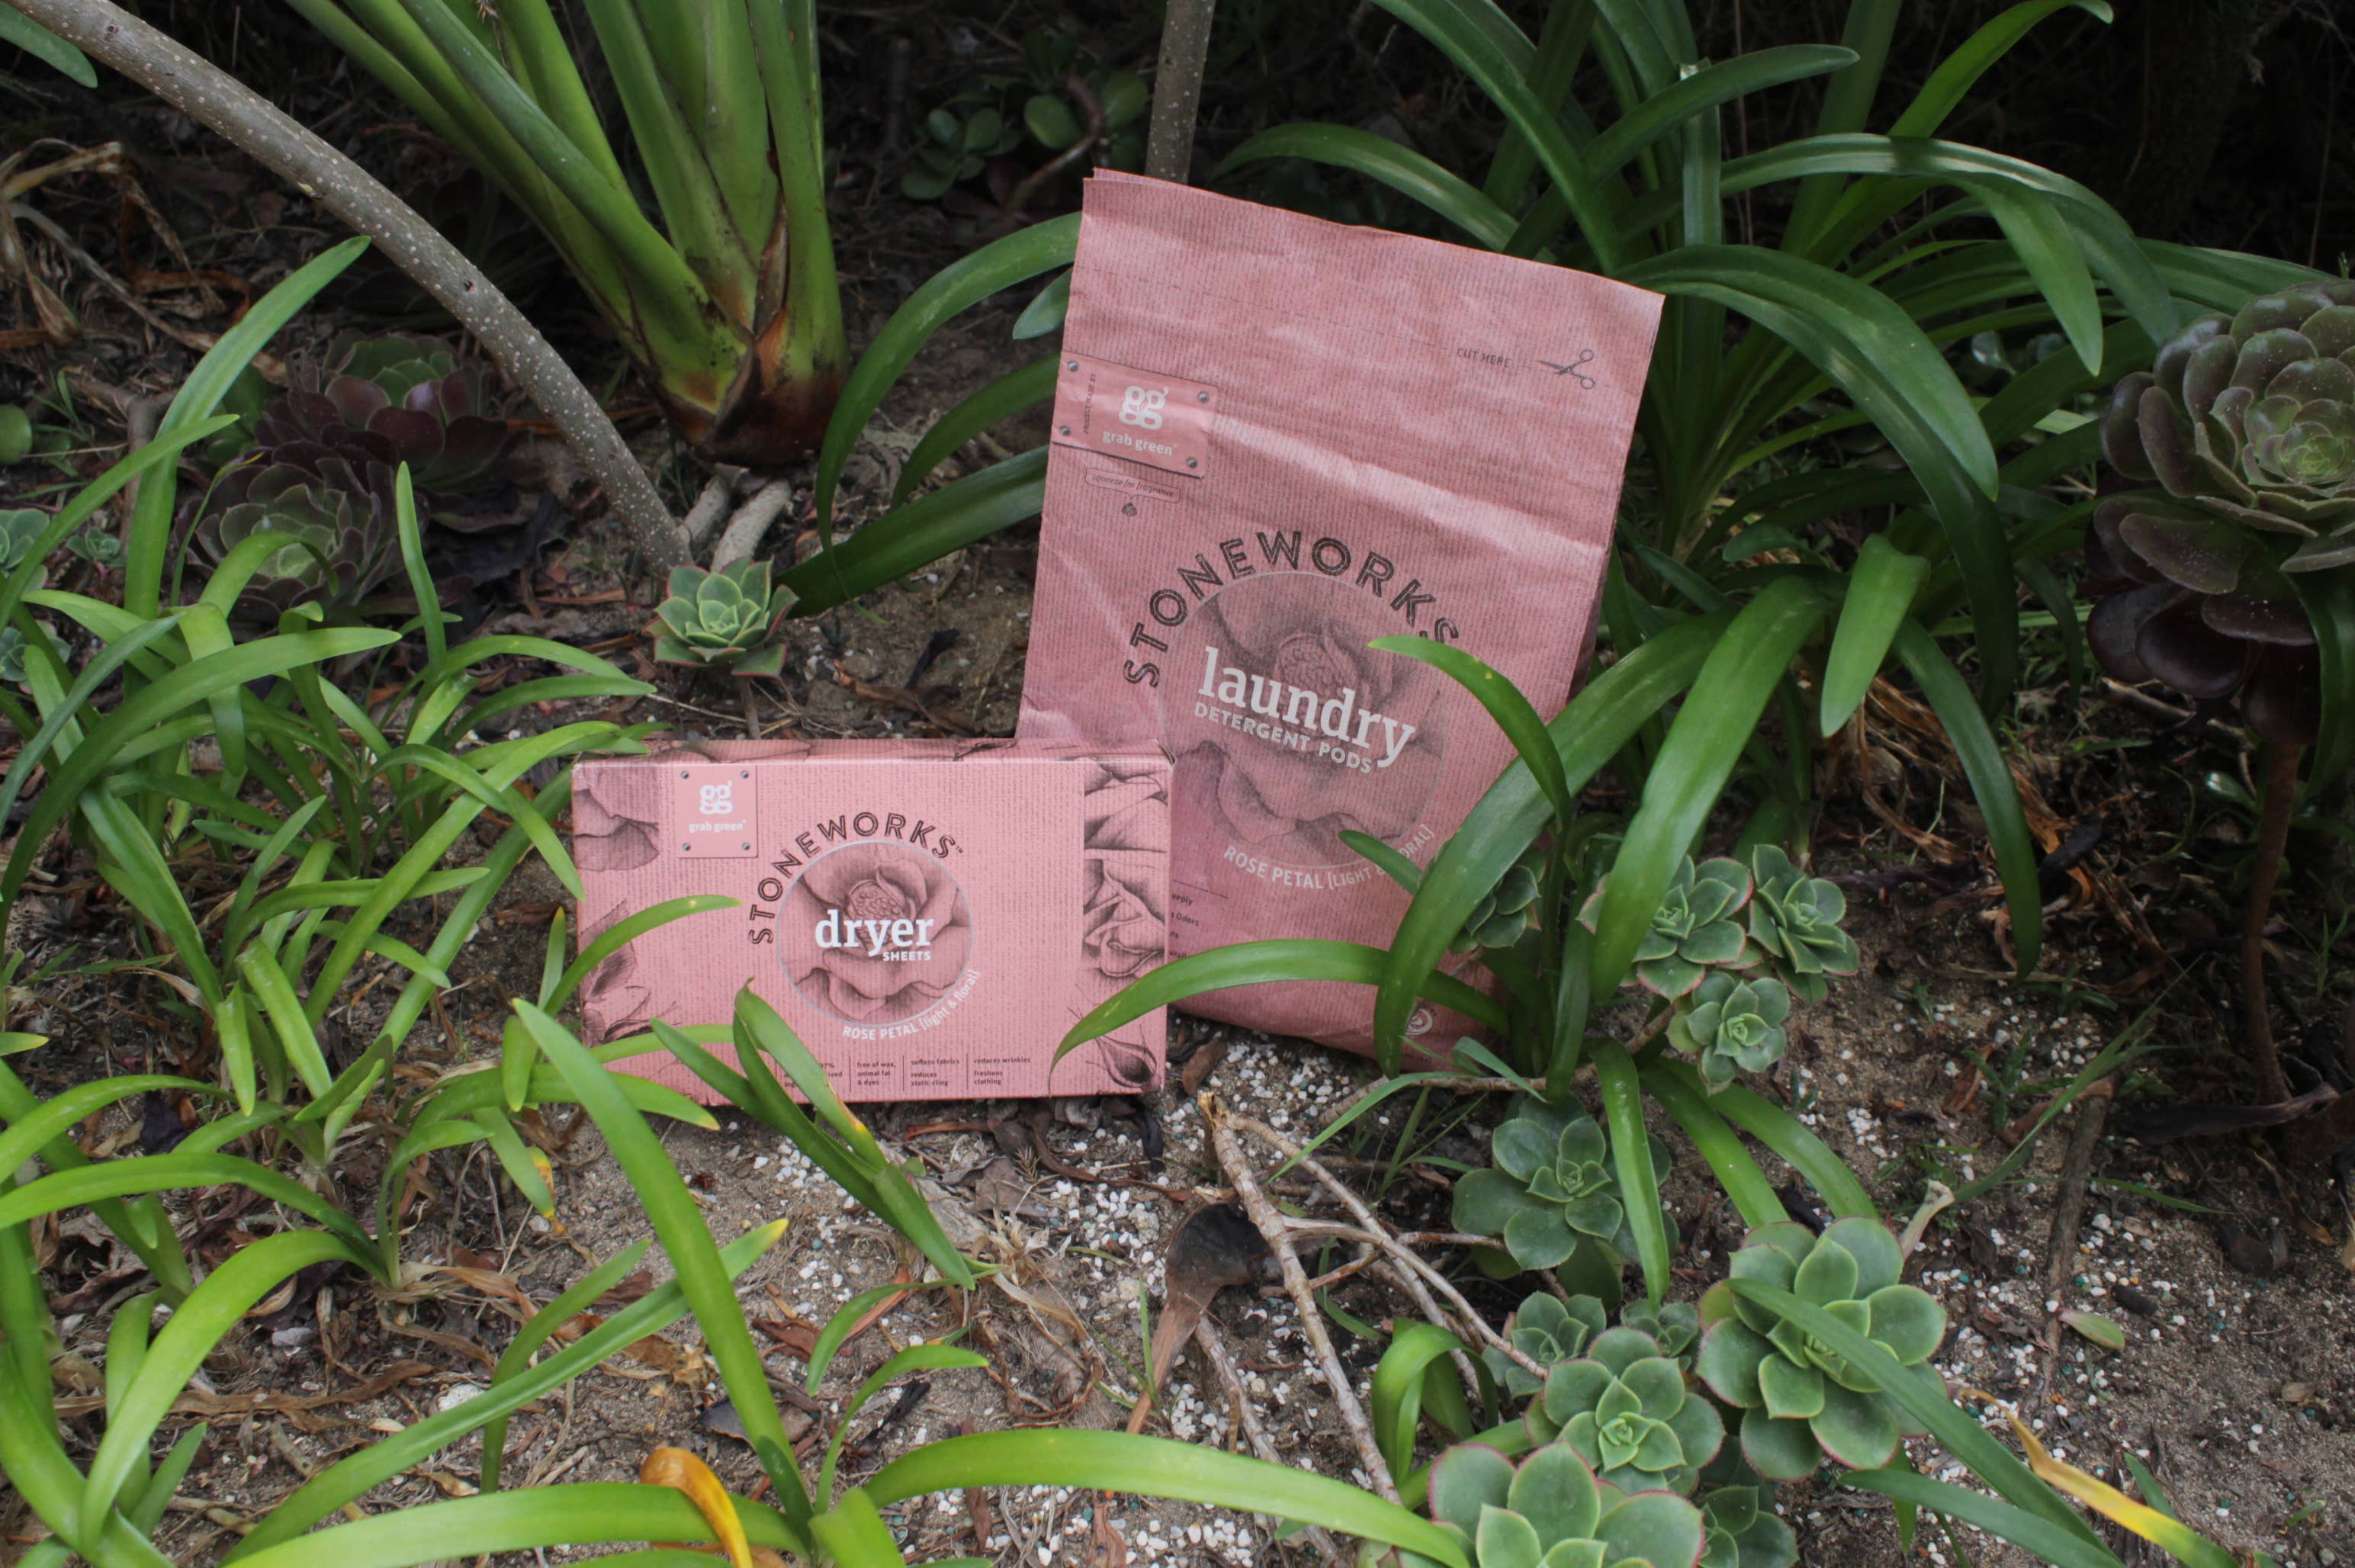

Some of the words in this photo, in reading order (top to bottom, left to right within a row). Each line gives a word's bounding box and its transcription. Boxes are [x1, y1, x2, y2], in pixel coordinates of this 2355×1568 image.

[1457, 348, 1479, 362] CUT
[1482, 352, 1511, 367] HERE
[1103, 431, 1133, 445] grab
[1091, 474, 1123, 487] squeeze
[1123, 479, 1136, 489] for
[1137, 482, 1174, 497] fragrance
[1197, 646, 1416, 768] laundry
[1194, 702, 1310, 751] DETERGENT
[1319, 741, 1372, 774] PODS
[689, 821, 712, 834] grab
[1223, 845, 1268, 879] ROSE
[1272, 866, 1324, 889] PETAL
[1176, 912, 1199, 927] Odors
[815, 909, 934, 957] dryer
[882, 950, 932, 962] SHEETS
[842, 1026, 877, 1040] ROSE
[880, 1023, 919, 1039] PETAL
[947, 999, 957, 1009] &
[974, 1078, 1001, 1086] clothing
